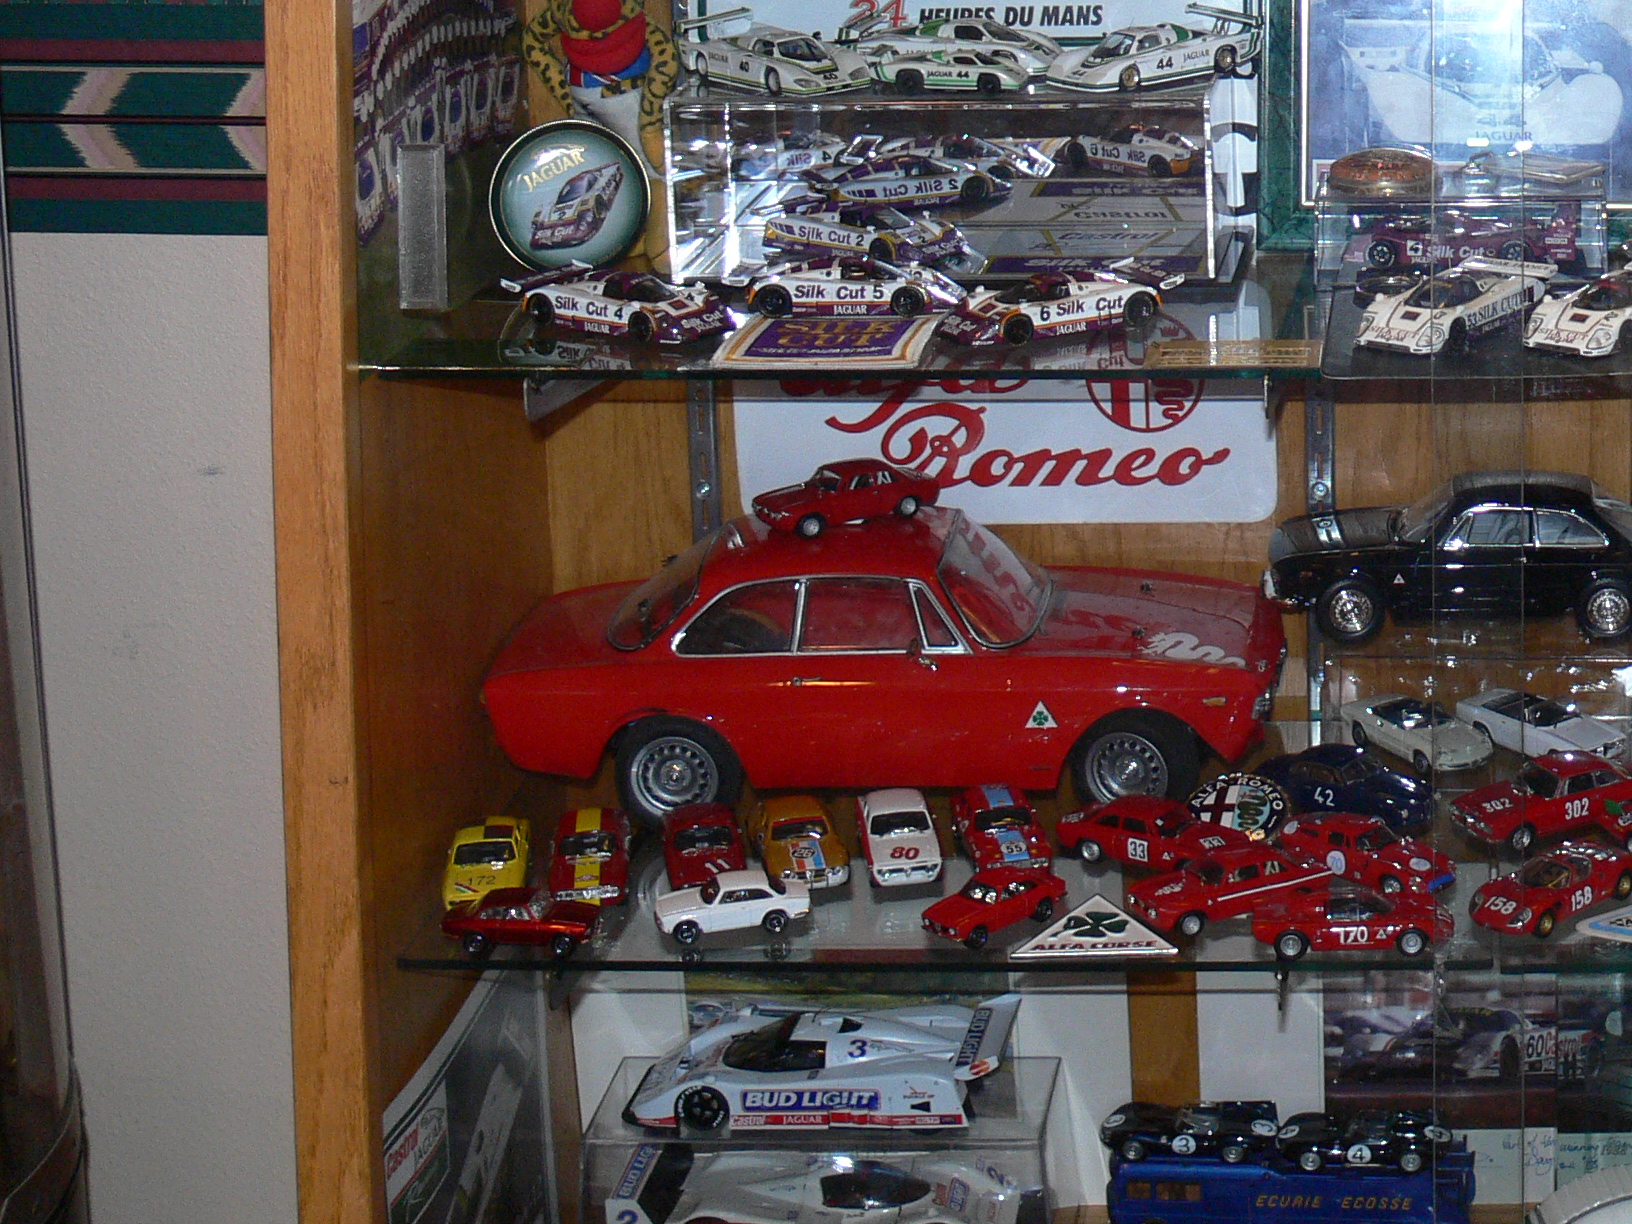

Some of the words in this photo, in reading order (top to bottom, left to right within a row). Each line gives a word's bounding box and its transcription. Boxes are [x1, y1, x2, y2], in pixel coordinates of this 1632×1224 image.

[1004, 5, 1035, 27] DU
[1039, 4, 1104, 27] MANS
[739, 59, 750, 73] 40
[1155, 55, 1175, 71] 44
[1182, 48, 1211, 63] JAGUAR
[927, 70, 953, 78] JAGUAR
[956, 70, 971, 79] 44
[1475, 130, 1533, 142] JAGUAR
[522, 150, 588, 194] JAGUAR
[797, 226, 823, 243] Silk
[827, 231, 851, 246] Cut
[855, 234, 866, 247] 2
[1426, 245, 1455, 259] Silk
[1458, 245, 1486, 258] Cut
[793, 284, 827, 300] Silk
[836, 284, 867, 301] Cut
[872, 284, 885, 300] 5
[554, 295, 579, 312] Silk
[585, 301, 609, 319] Cut
[613, 306, 625, 321] 4
[833, 303, 868, 316] JAGUAR
[1039, 305, 1051, 322] 6
[1055, 300, 1086, 317] Silk
[1095, 295, 1124, 312] Cut
[1478, 303, 1498, 322] SILK
[584, 321, 611, 335] JAGUAR
[1056, 322, 1087, 336] JAGUAR
[881, 401, 1232, 490] Romeo
[1193, 780, 1227, 808] ALFA
[1237, 777, 1284, 812] ROMEO
[1313, 786, 1336, 807] 42
[1481, 798, 1514, 814] 302
[1563, 797, 1590, 821] 302
[889, 846, 920, 861] 80
[1005, 842, 1024, 854] 55
[1128, 842, 1147, 861] 33
[704, 858, 732, 872] 11
[467, 875, 497, 886] 172
[1483, 895, 1518, 915] 158
[1570, 887, 1593, 912] 158
[1335, 926, 1369, 944] 170
[1031, 941, 1080, 952] ALFA
[1086, 939, 1158, 951] CORSE
[847, 1039, 868, 1059] 3
[1525, 1034, 1546, 1059] 60
[1545, 1031, 1582, 1056] Castrol
[745, 1091, 797, 1108] BUD
[801, 1090, 879, 1108] LIGHT
[731, 1114, 766, 1126] Castrol
[782, 1113, 824, 1125] JAGUAR
[1178, 1137, 1190, 1153] 3
[1352, 1146, 1365, 1162] 4
[1255, 1194, 1322, 1209] ECURIE
[1341, 1195, 1415, 1211] ECOSSE
